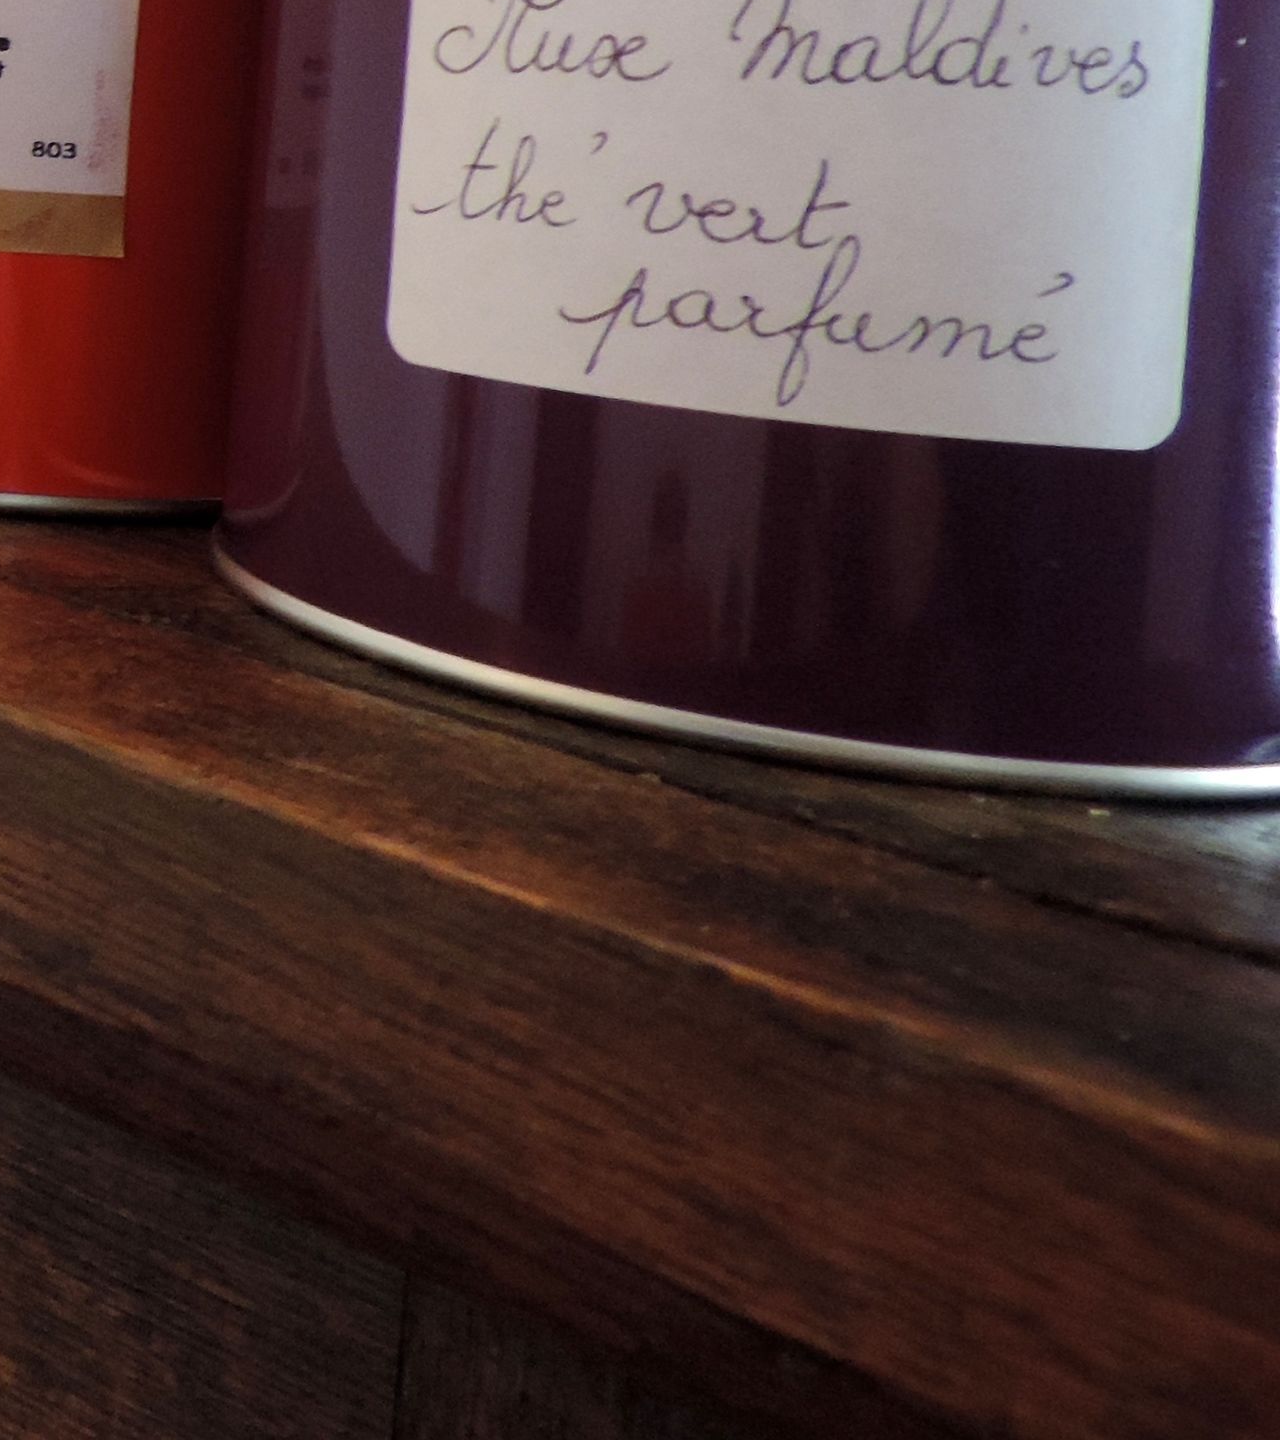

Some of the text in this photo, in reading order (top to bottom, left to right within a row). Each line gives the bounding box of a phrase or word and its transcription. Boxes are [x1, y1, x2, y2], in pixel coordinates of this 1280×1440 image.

[31, 140, 78, 160] 803
[411, 116, 852, 250] thé vert
[558, 234, 1079, 410] parfumé
